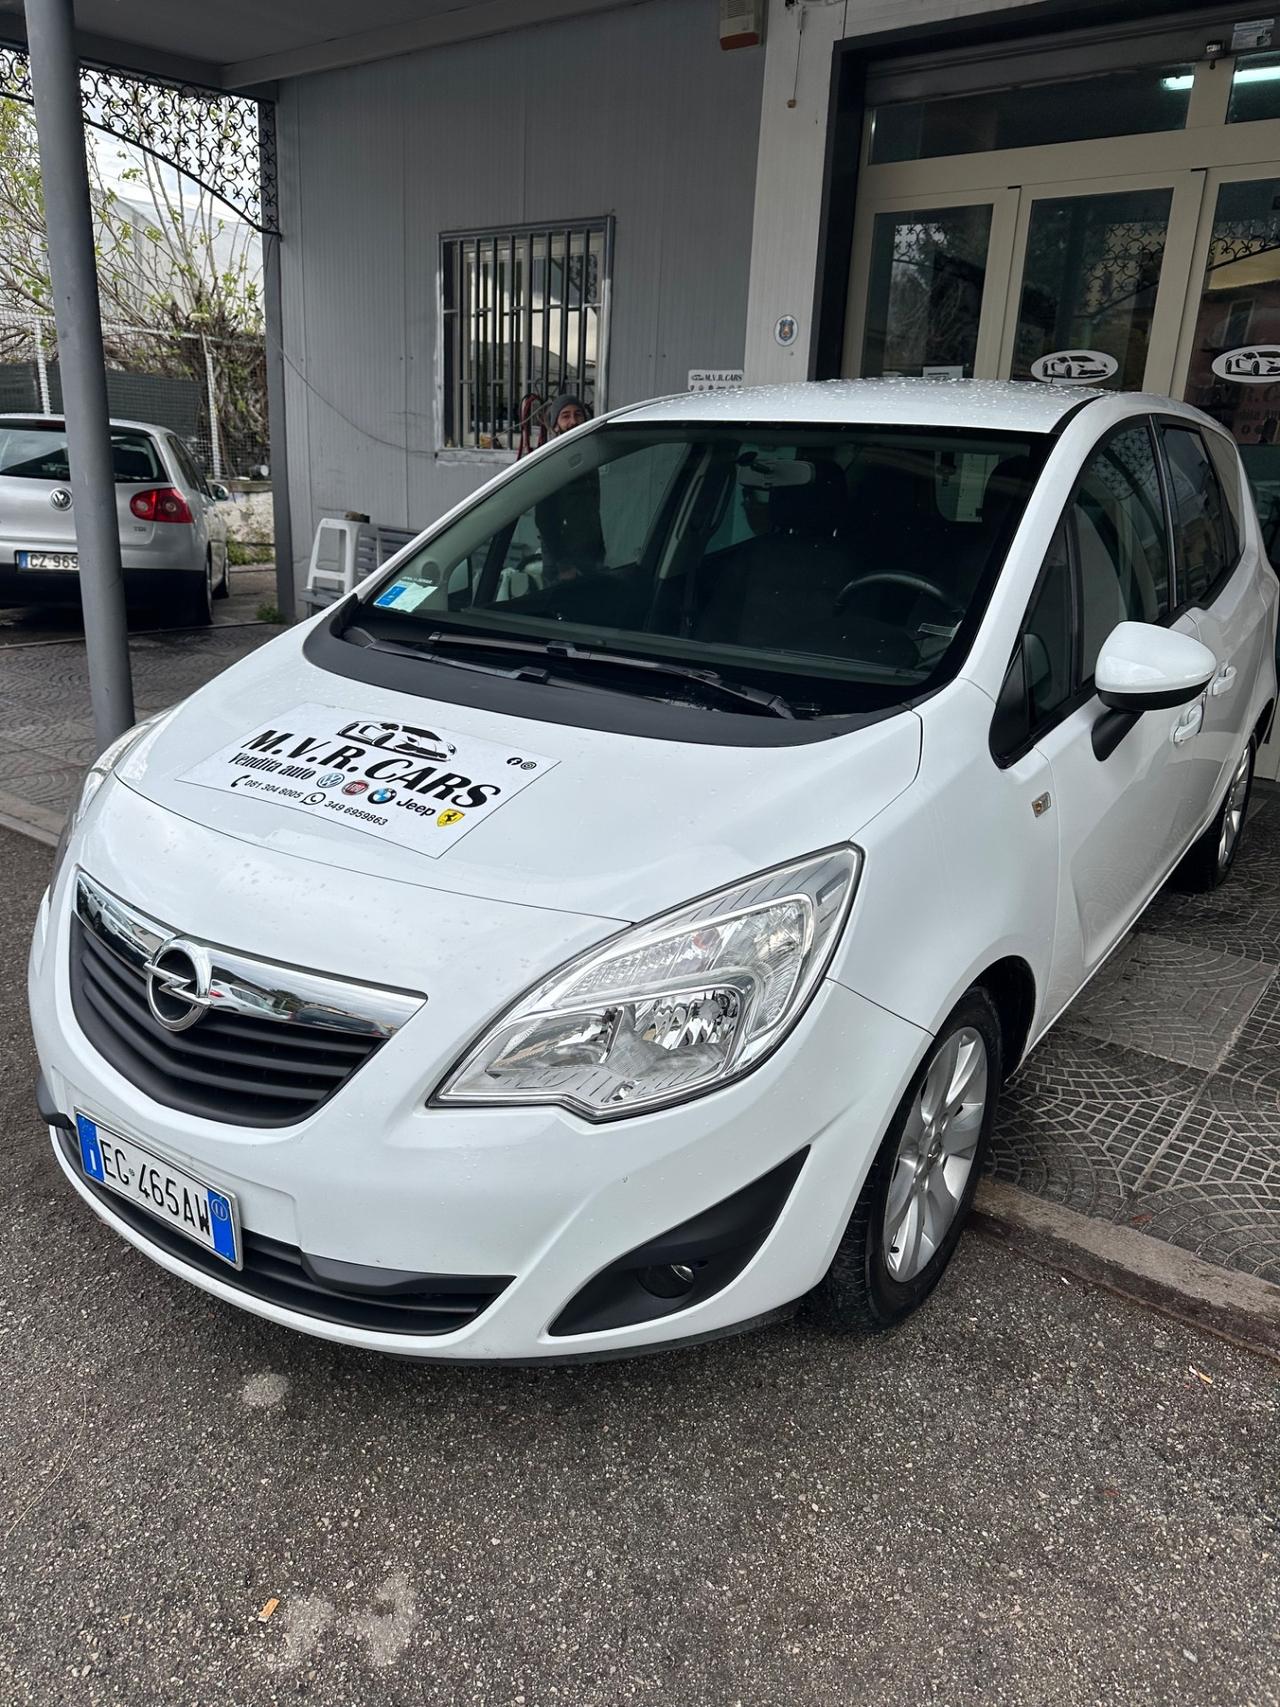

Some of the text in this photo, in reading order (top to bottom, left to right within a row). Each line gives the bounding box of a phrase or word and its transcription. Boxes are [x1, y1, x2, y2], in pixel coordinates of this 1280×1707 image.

[228, 752, 317, 780] Vendita auto
[364, 758, 501, 808] CARS
[324, 800, 388, 826] 349 6959863
[396, 798, 436, 816] Jeep
